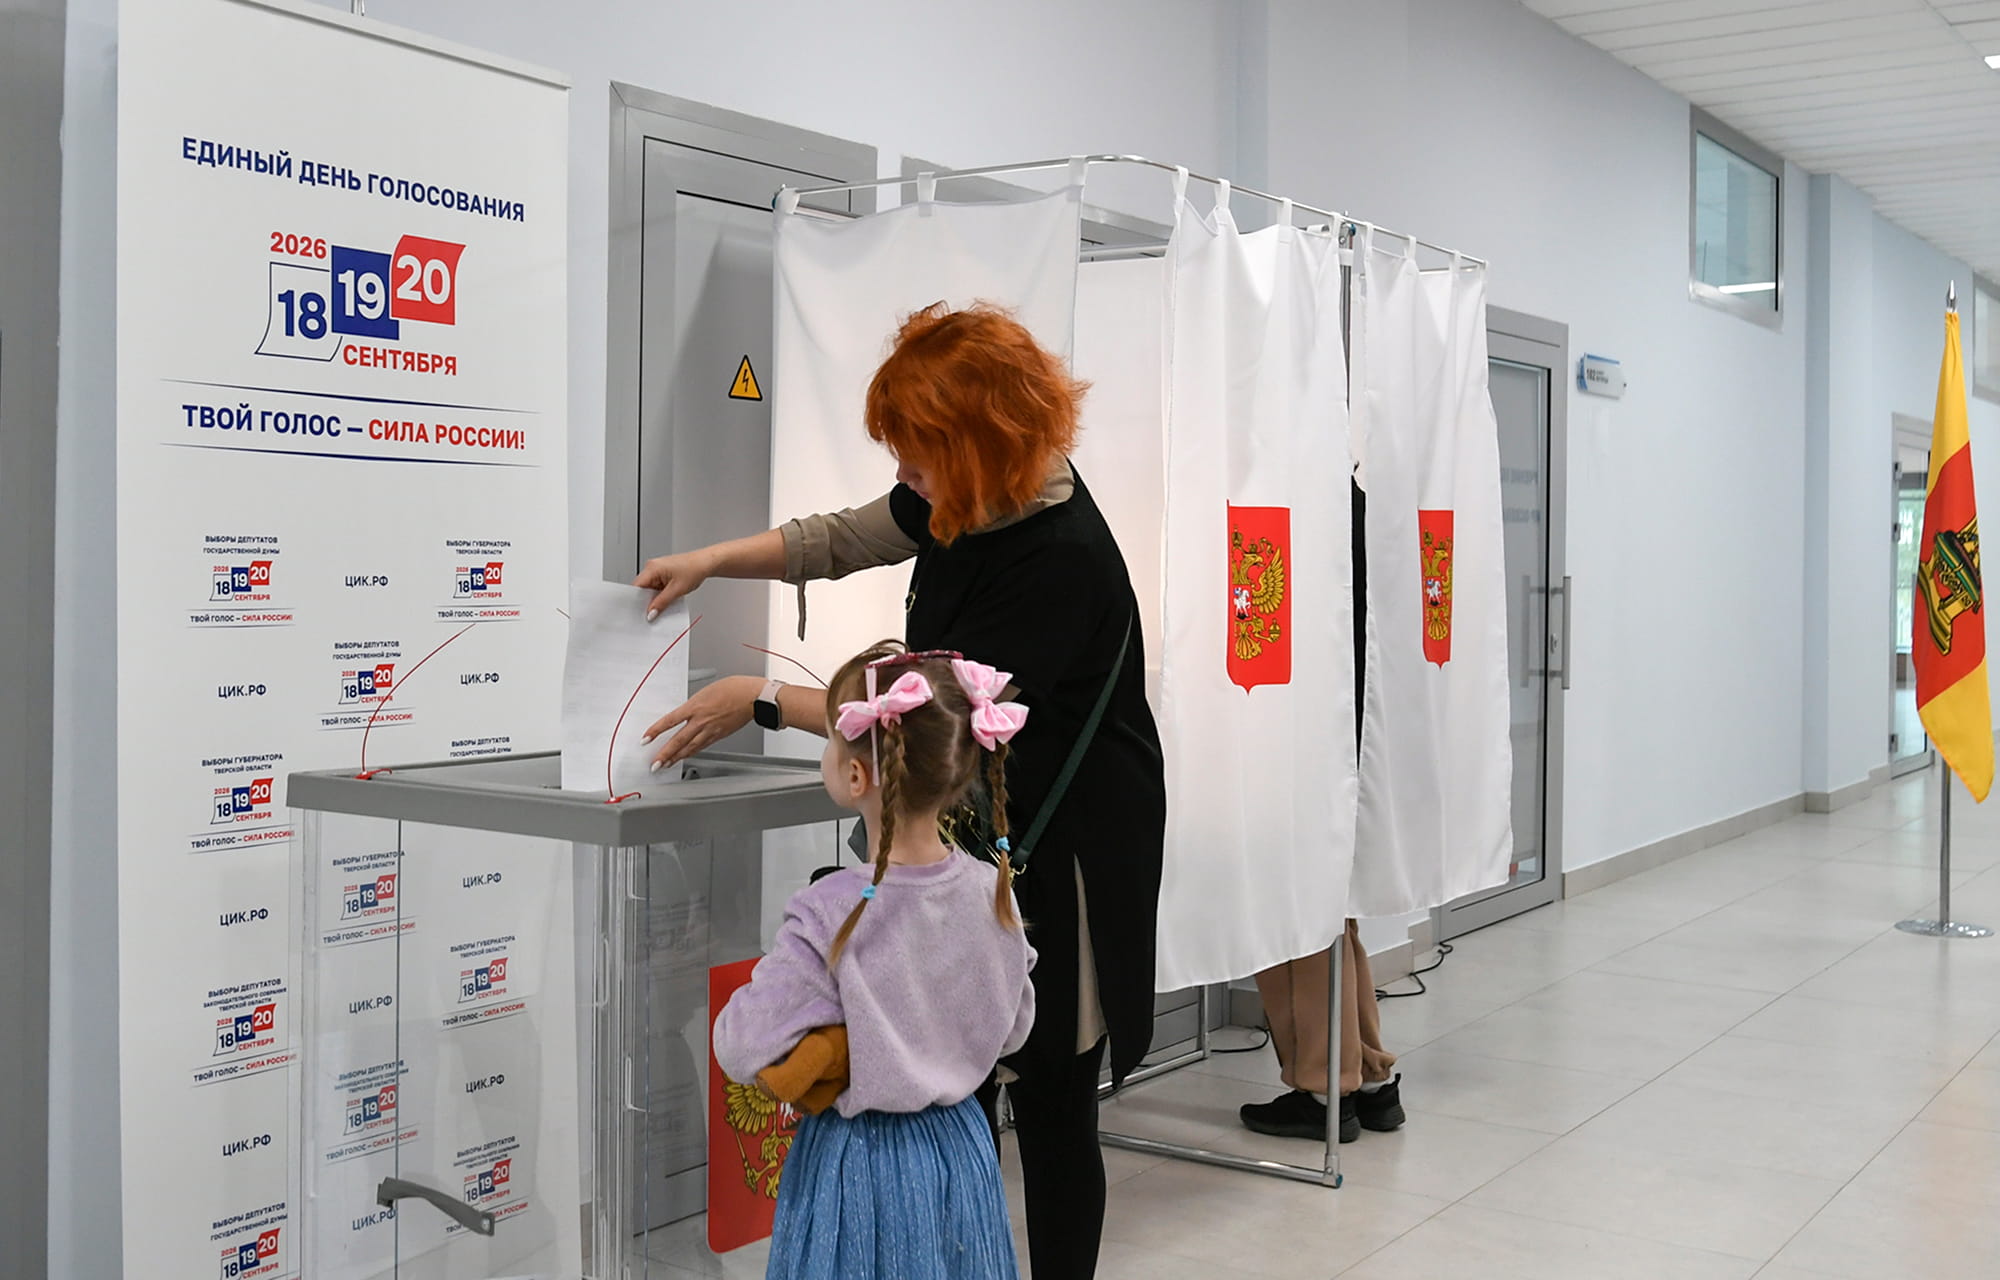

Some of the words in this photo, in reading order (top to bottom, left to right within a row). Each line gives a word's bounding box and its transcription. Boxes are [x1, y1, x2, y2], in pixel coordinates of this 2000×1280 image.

[183, 137, 292, 178] ЕДИНЫЙ
[299, 160, 362, 191] ДЕНЬ
[368, 173, 524, 222] ГОЛОСОВАНИЯ
[270, 232, 327, 259] 2026
[277, 289, 327, 340] 18
[338, 269, 385, 320] 19
[396, 255, 451, 304] 20
[343, 344, 457, 376] СЕНТЯБРЯ
[182, 403, 252, 430] ТВОЙ
[261, 411, 341, 437] ГОЛОС
[369, 418, 428, 443] СИЛА
[435, 425, 525, 450] РОССИИ!
[216, 581, 230, 595] 18
[233, 573, 247, 587] 19
[251, 567, 268, 580] 20
[345, 575, 388, 588] ЦИК.РФ
[458, 581, 470, 592] 18
[472, 573, 483, 585] 19
[486, 568, 500, 579] 20
[191, 614, 209, 622] ТВОЙ
[333, 652, 384, 660] ГОСУДАРСТВЕННОЙ
[344, 685, 357, 698] 18
[360, 676, 373, 690] 19
[375, 669, 391, 682] 20
[461, 672, 499, 685] ЦИК.РФ
[218, 684, 266, 698] ЦИК.РФ
[321, 717, 338, 725] ТВОЙ
[202, 758, 233, 766] ВЫБОРЫ
[235, 754, 283, 763] ГУБЕРНАТОРА
[214, 766, 244, 774] ТВЕРСКОЙ
[217, 803, 231, 817] 18
[234, 793, 248, 807] 19
[252, 784, 269, 799] 20
[236, 812, 271, 821] СЕНТЯБРЯ
[191, 838, 210, 848] ТВОЙ
[212, 837, 236, 845] ГОЛОС
[243, 833, 262, 842] СИЛА
[333, 857, 360, 865] ВЫБОРЫ
[362, 851, 405, 861] ГУБЕРНАТОА
[344, 864, 370, 872] ТВЕРСКОЙ
[462, 872, 502, 888] ЦИК.РФ
[346, 900, 359, 913] 18
[362, 889, 374, 903] 19
[377, 880, 392, 894] 20
[220, 908, 269, 927] ЦИК.РФ
[323, 933, 341, 943] ТВОЙ
[342, 931, 364, 940] ГОЛОС
[208, 986, 239, 998] ВЫБОРЫ
[241, 979, 281, 991] ДЕПУТАТОВ
[463, 984, 474, 996] 18
[477, 973, 488, 986] 19
[491, 964, 504, 977] 20
[219, 1002, 246, 1011] ТВЕРСКОЙ
[248, 998, 271, 1006] ОБЛАСТИ
[349, 995, 392, 1014] ЦИК.РФ
[219, 1033, 233, 1048] 18
[236, 1021, 251, 1036] 19
[255, 1011, 271, 1026] 20
[238, 1038, 274, 1050] СЕНТЯБРЯ
[194, 1070, 213, 1082] ТВОЙ
[215, 1066, 238, 1076] ГОЛОС
[246, 1061, 265, 1070] СИЛА
[466, 1074, 505, 1093] ЦИК.РФ
[349, 1113, 361, 1128] 18
[365, 1102, 377, 1116] 19
[380, 1091, 396, 1106] 20
[222, 1134, 272, 1157] ЦИК.РФ
[466, 1188, 478, 1201] 18
[481, 1177, 492, 1191] 19
[494, 1166, 508, 1180] 20
[213, 1215, 244, 1229] ВЫБОРЫ
[245, 1202, 285, 1220] ДЕПУТАТОВ
[211, 1219, 268, 1241] ГОСУДАРСТВЕННОЙ
[224, 1262, 238, 1278] 18
[241, 1249, 255, 1265] 19
[259, 1236, 276, 1252] 20
